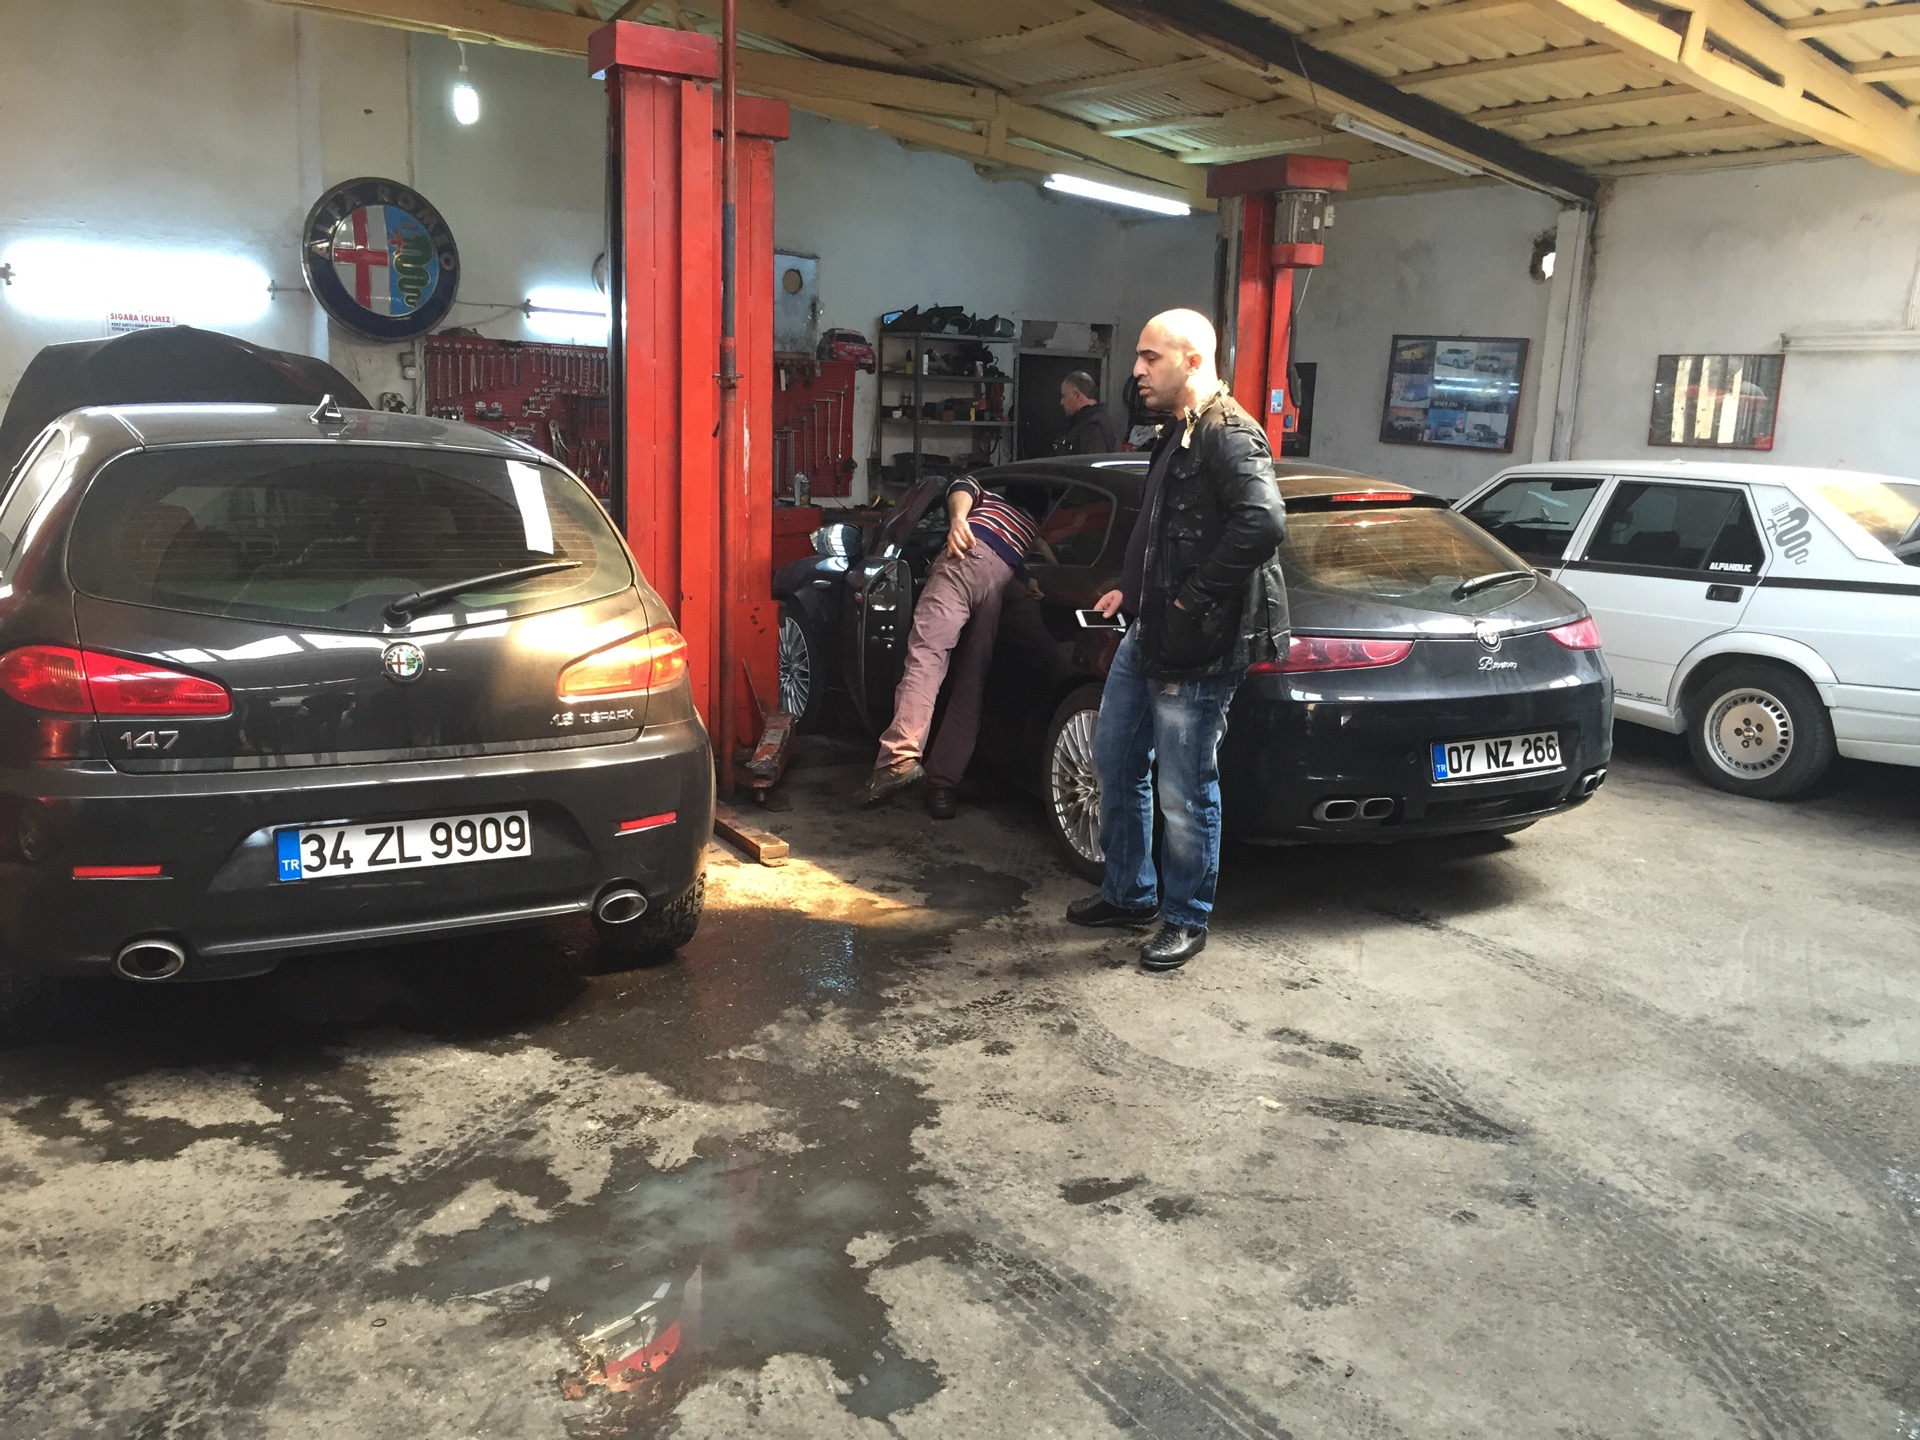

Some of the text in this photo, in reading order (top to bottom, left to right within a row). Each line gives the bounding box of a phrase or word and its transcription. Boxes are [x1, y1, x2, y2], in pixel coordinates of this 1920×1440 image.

[309, 184, 456, 272] ALFA ROMEO
[1709, 562, 1752, 573] ALFAHOLIC
[120, 730, 179, 750] 147
[1436, 735, 1557, 774] TR 07 NZ 266
[282, 815, 526, 872] TR 34 ZL 9909
